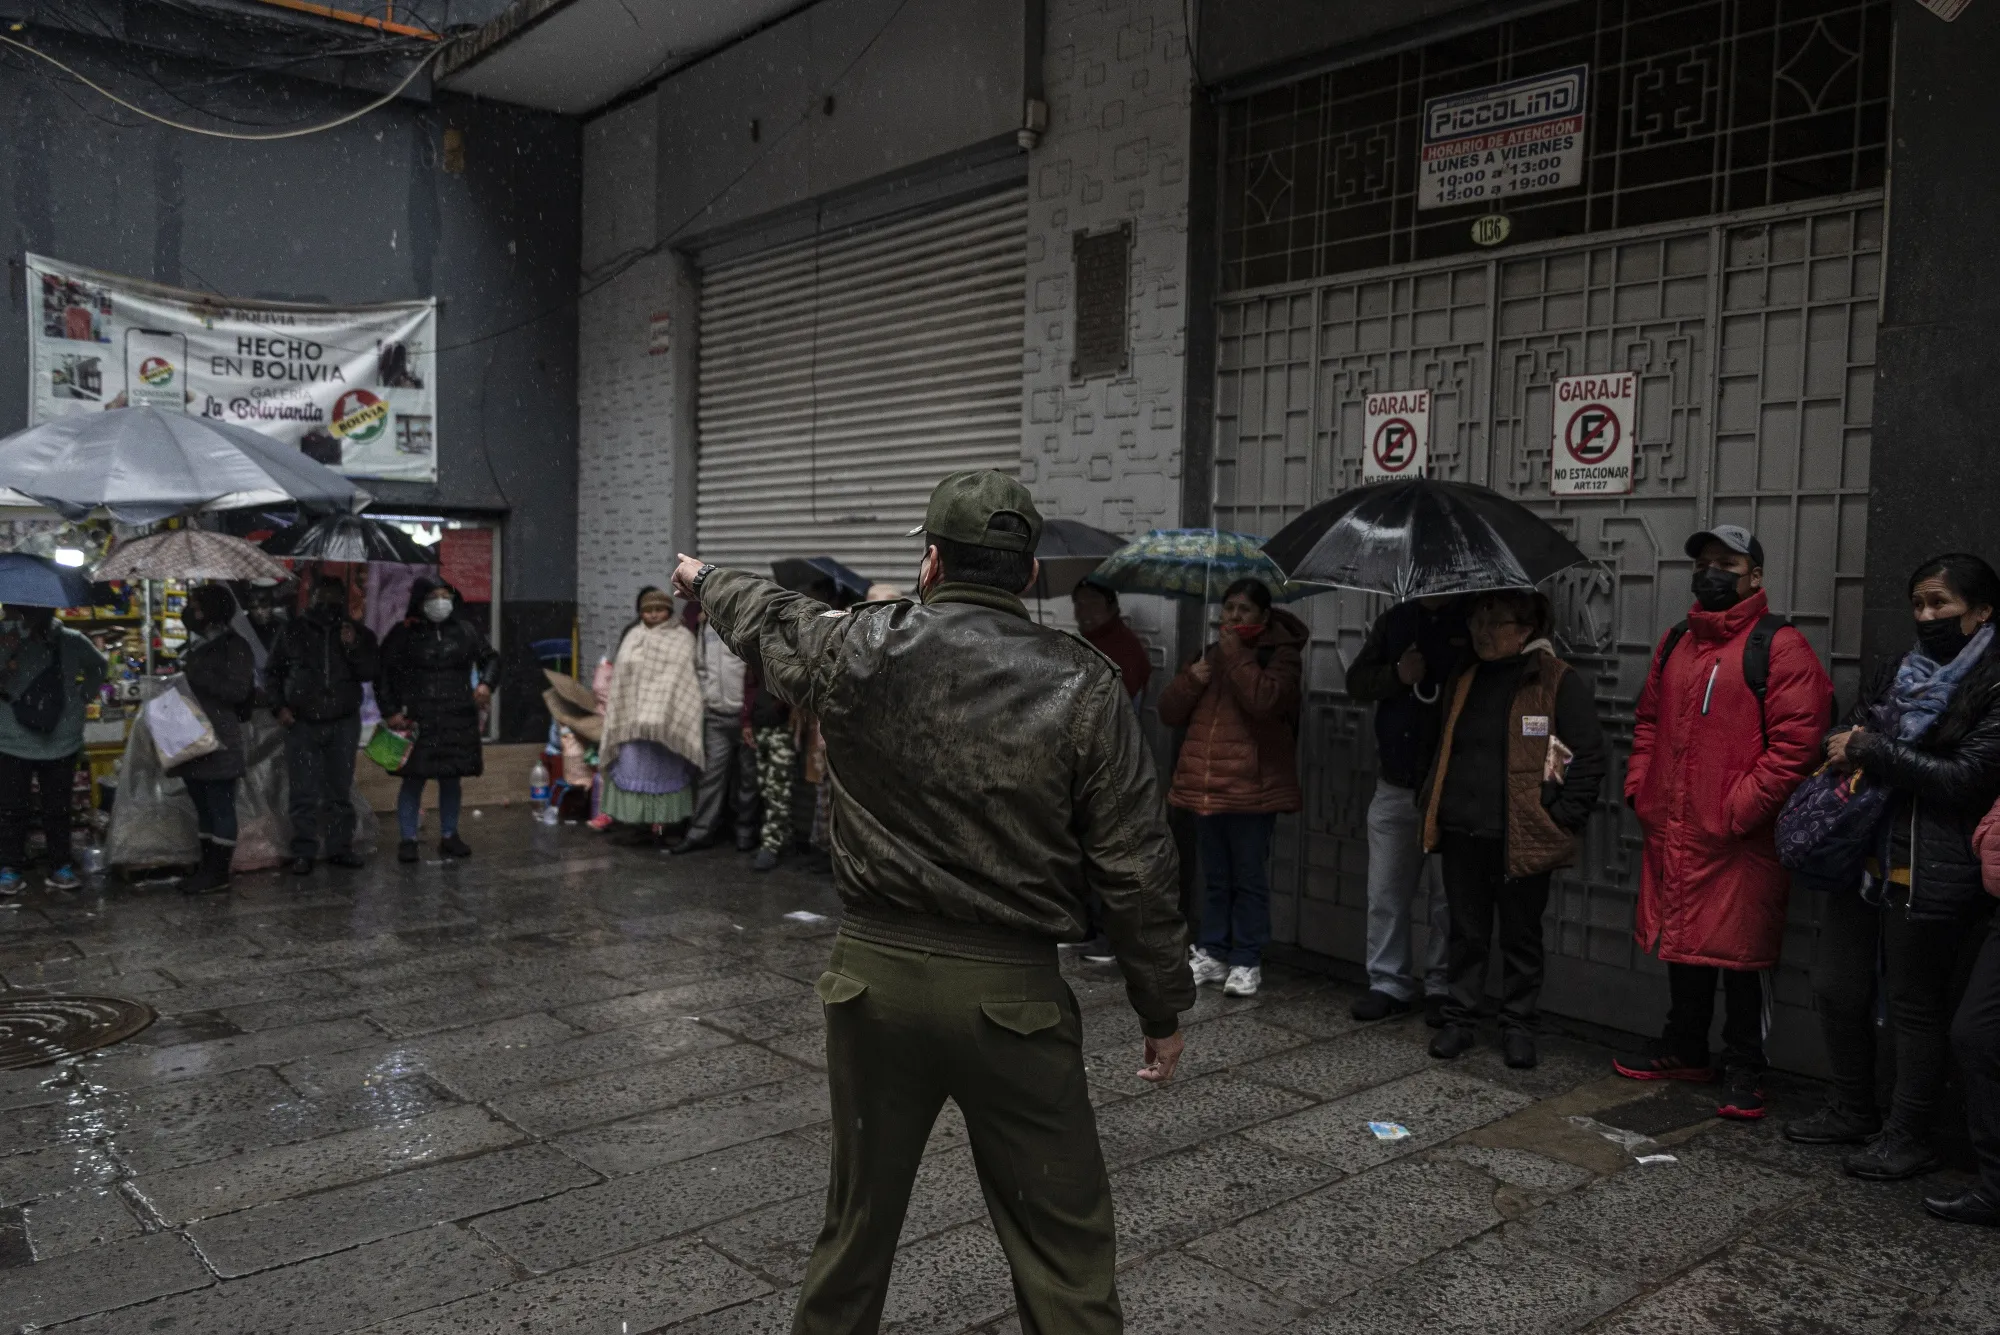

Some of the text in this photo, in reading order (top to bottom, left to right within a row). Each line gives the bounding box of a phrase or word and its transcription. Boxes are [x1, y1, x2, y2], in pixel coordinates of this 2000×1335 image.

[1428, 120, 1576, 159] HORARIO DE ATENCIÓN
[1428, 136, 1574, 175] LUNES A VIERNES
[1437, 170, 1486, 188] 10:00
[1510, 156, 1561, 175] 13:00
[1436, 185, 1485, 202] 15:00
[1509, 172, 1561, 191] 19:00
[1478, 218, 1500, 243] 1136
[236, 311, 296, 326] BOLIVIA
[237, 336, 323, 361] HECHO
[211, 356, 346, 383] EN BOLIVIA
[1559, 376, 1633, 402] GARAJE
[202, 395, 223, 418] La
[229, 397, 324, 422] Bolivianita
[1368, 394, 1427, 416] GARAJE
[338, 405, 386, 432] BOLIVIA
[1554, 466, 1630, 480] NO ESTACIONAR
[1573, 481, 1609, 490] ART.127
